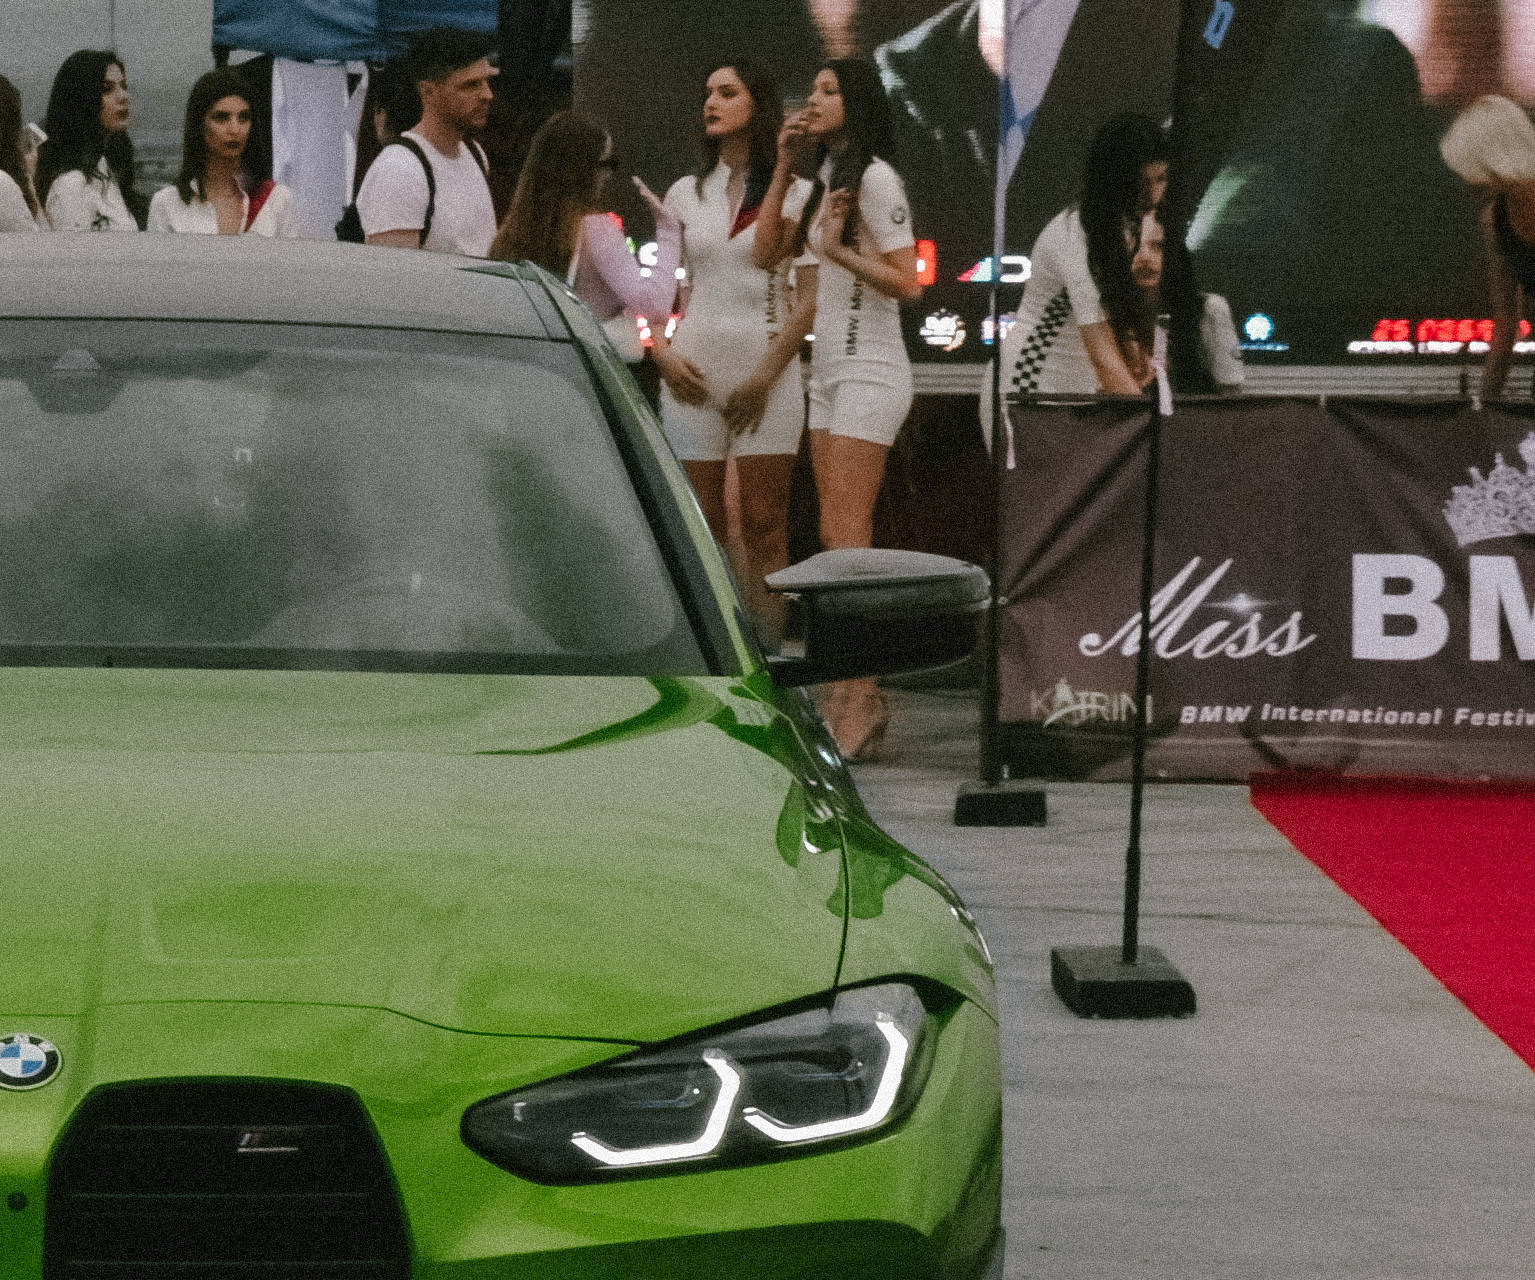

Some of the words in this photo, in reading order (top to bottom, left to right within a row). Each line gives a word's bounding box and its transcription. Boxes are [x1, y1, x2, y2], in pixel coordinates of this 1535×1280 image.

[1078, 556, 1318, 660] Miss
[1180, 705, 1253, 724] BMW
[1260, 703, 1443, 726] International
